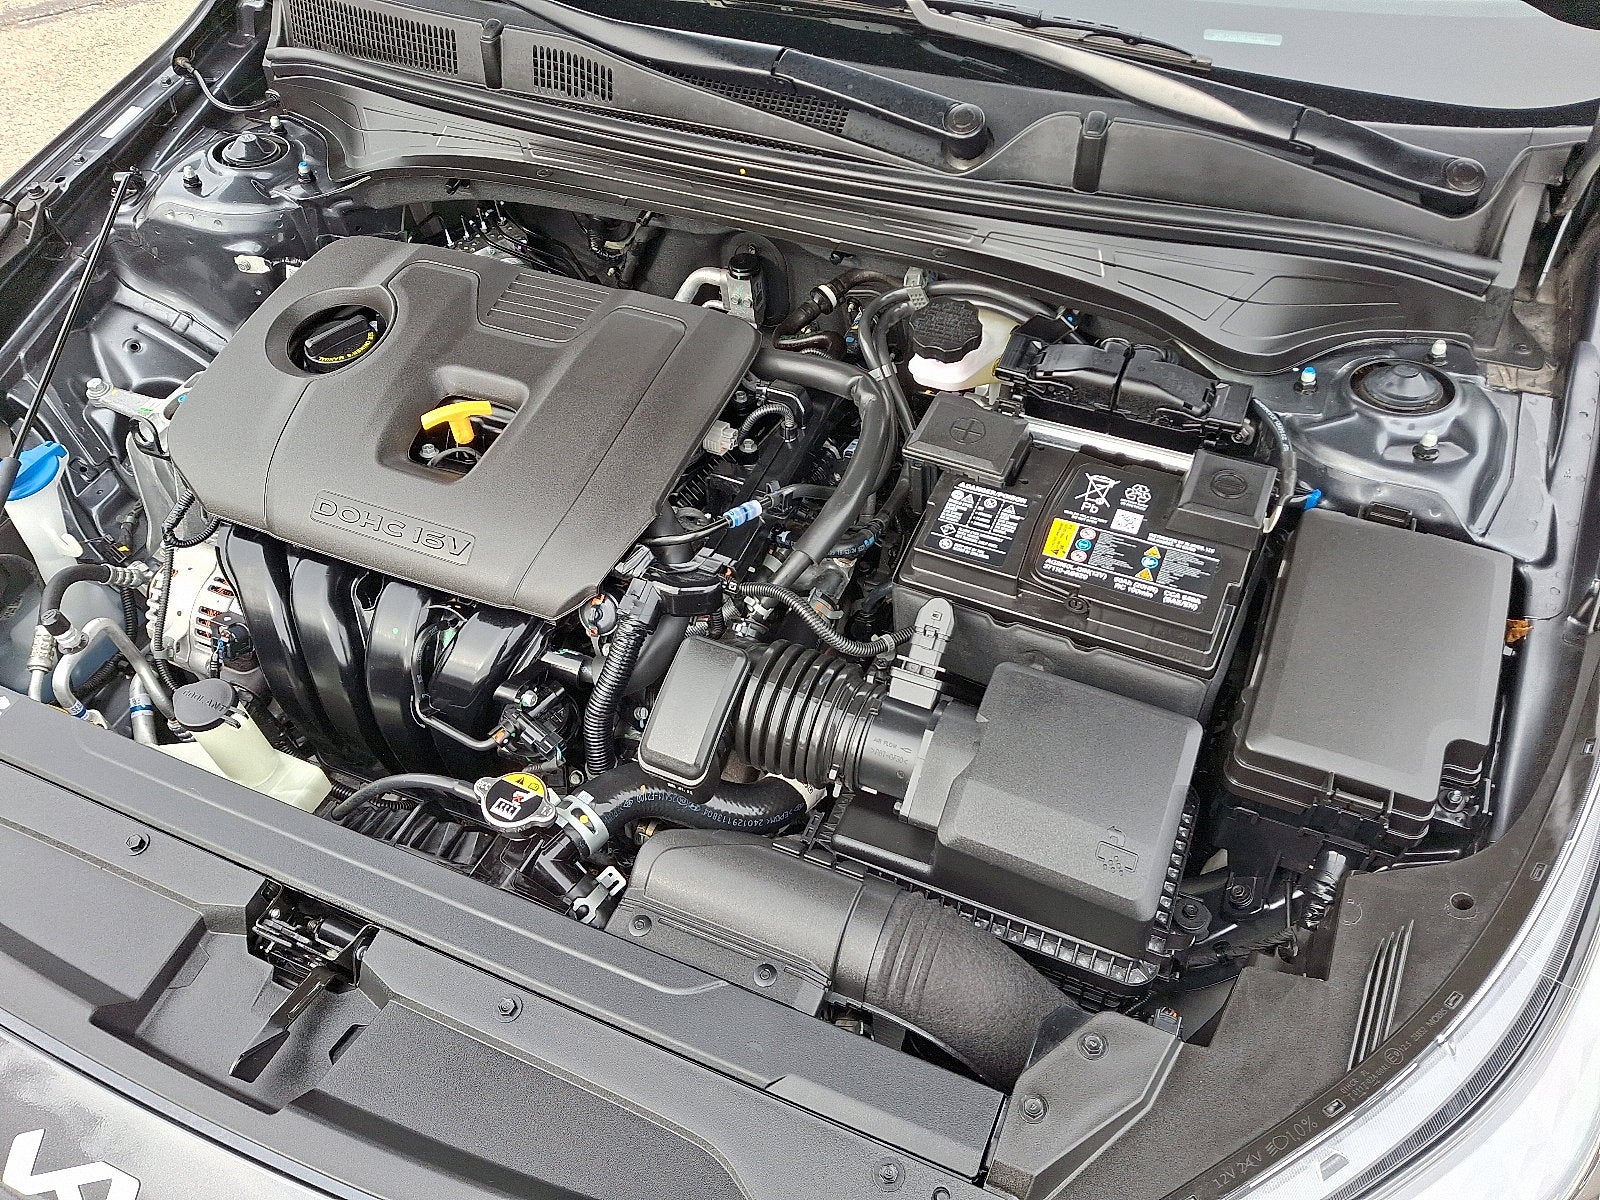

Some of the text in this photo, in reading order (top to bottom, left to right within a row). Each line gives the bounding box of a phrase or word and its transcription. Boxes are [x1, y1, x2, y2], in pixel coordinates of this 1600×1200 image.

[1080, 501, 1099, 514] Pb
[313, 498, 472, 557] DOHC 16V
[1163, 589, 1181, 599] CCA
[182, 689, 228, 712] COOLANT
[1212, 1165, 1236, 1189] 12V
